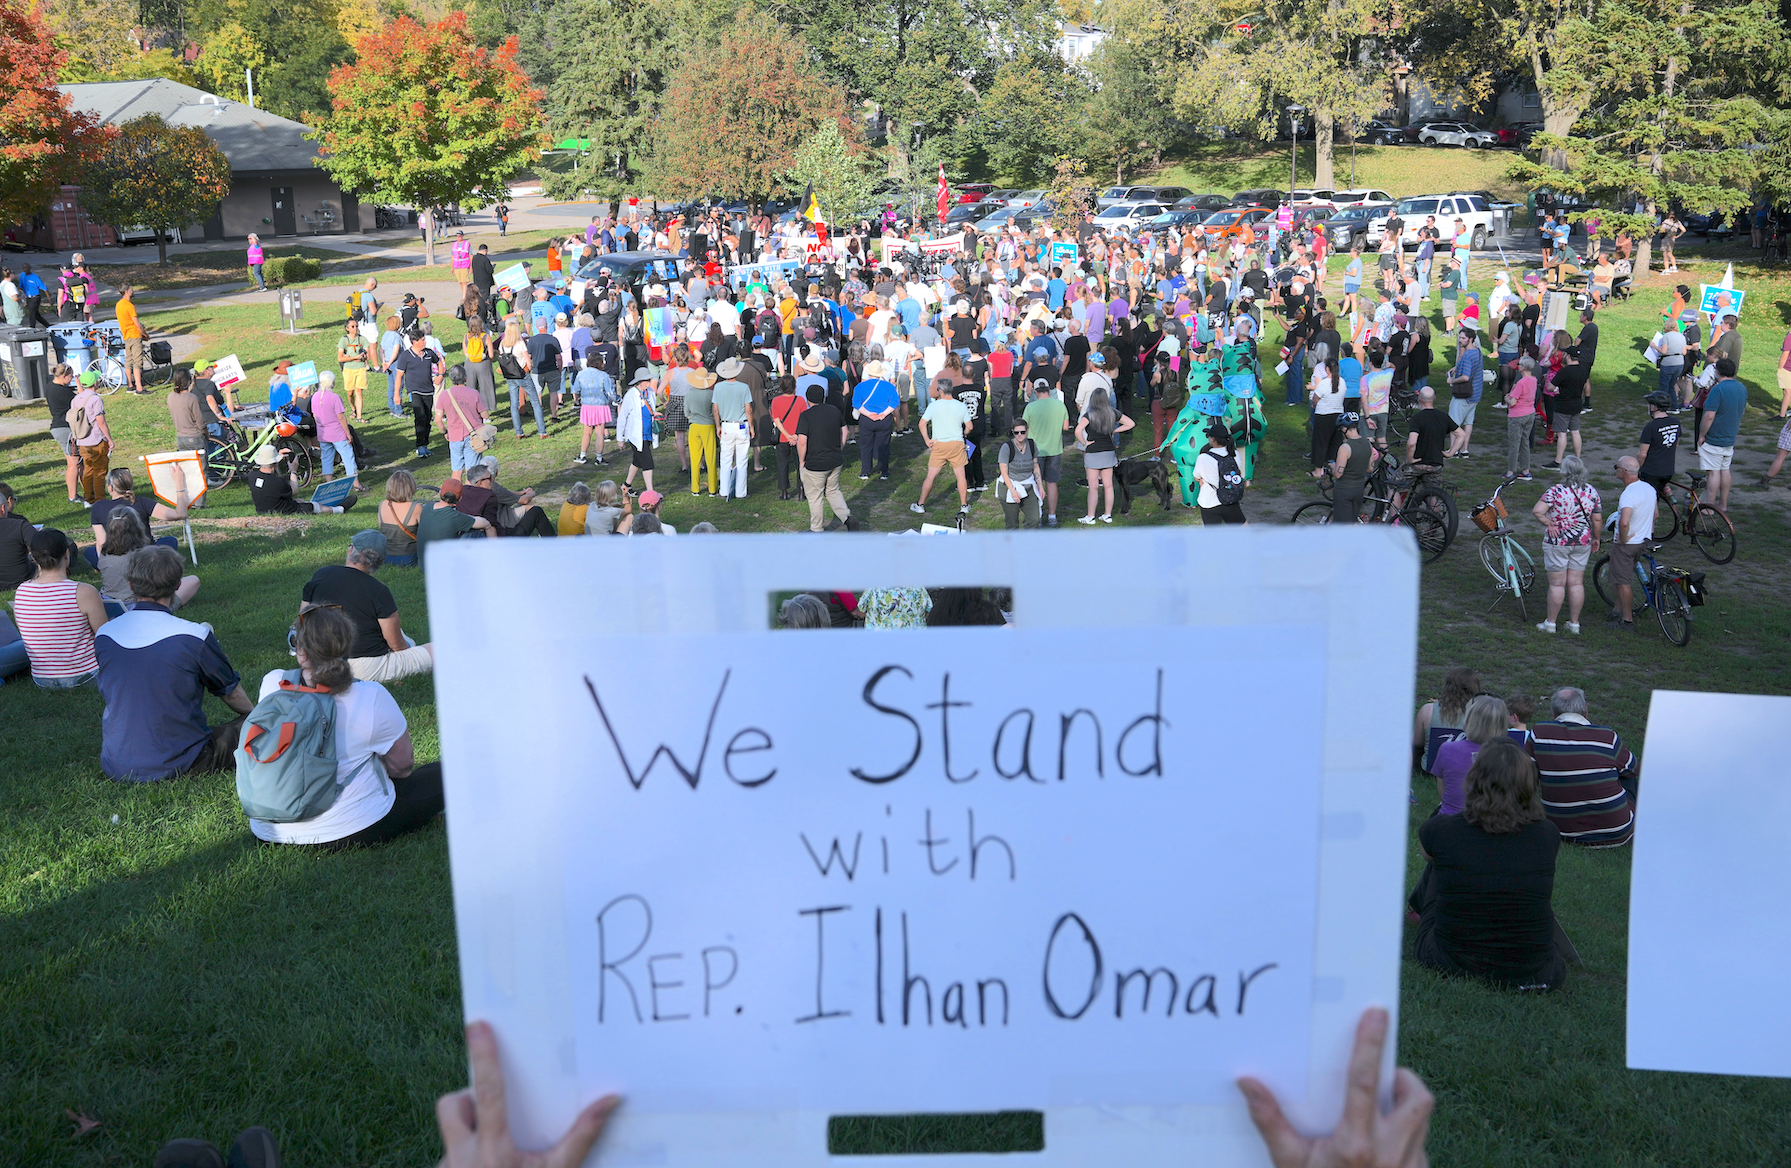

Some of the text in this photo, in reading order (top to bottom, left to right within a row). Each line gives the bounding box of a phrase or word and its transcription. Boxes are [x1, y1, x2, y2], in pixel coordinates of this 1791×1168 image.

[1662, 433, 1677, 445] 26
[583, 664, 1171, 790] We Stand
[801, 805, 1017, 882] with
[596, 893, 1279, 1029] REP. Ilhan Omar
